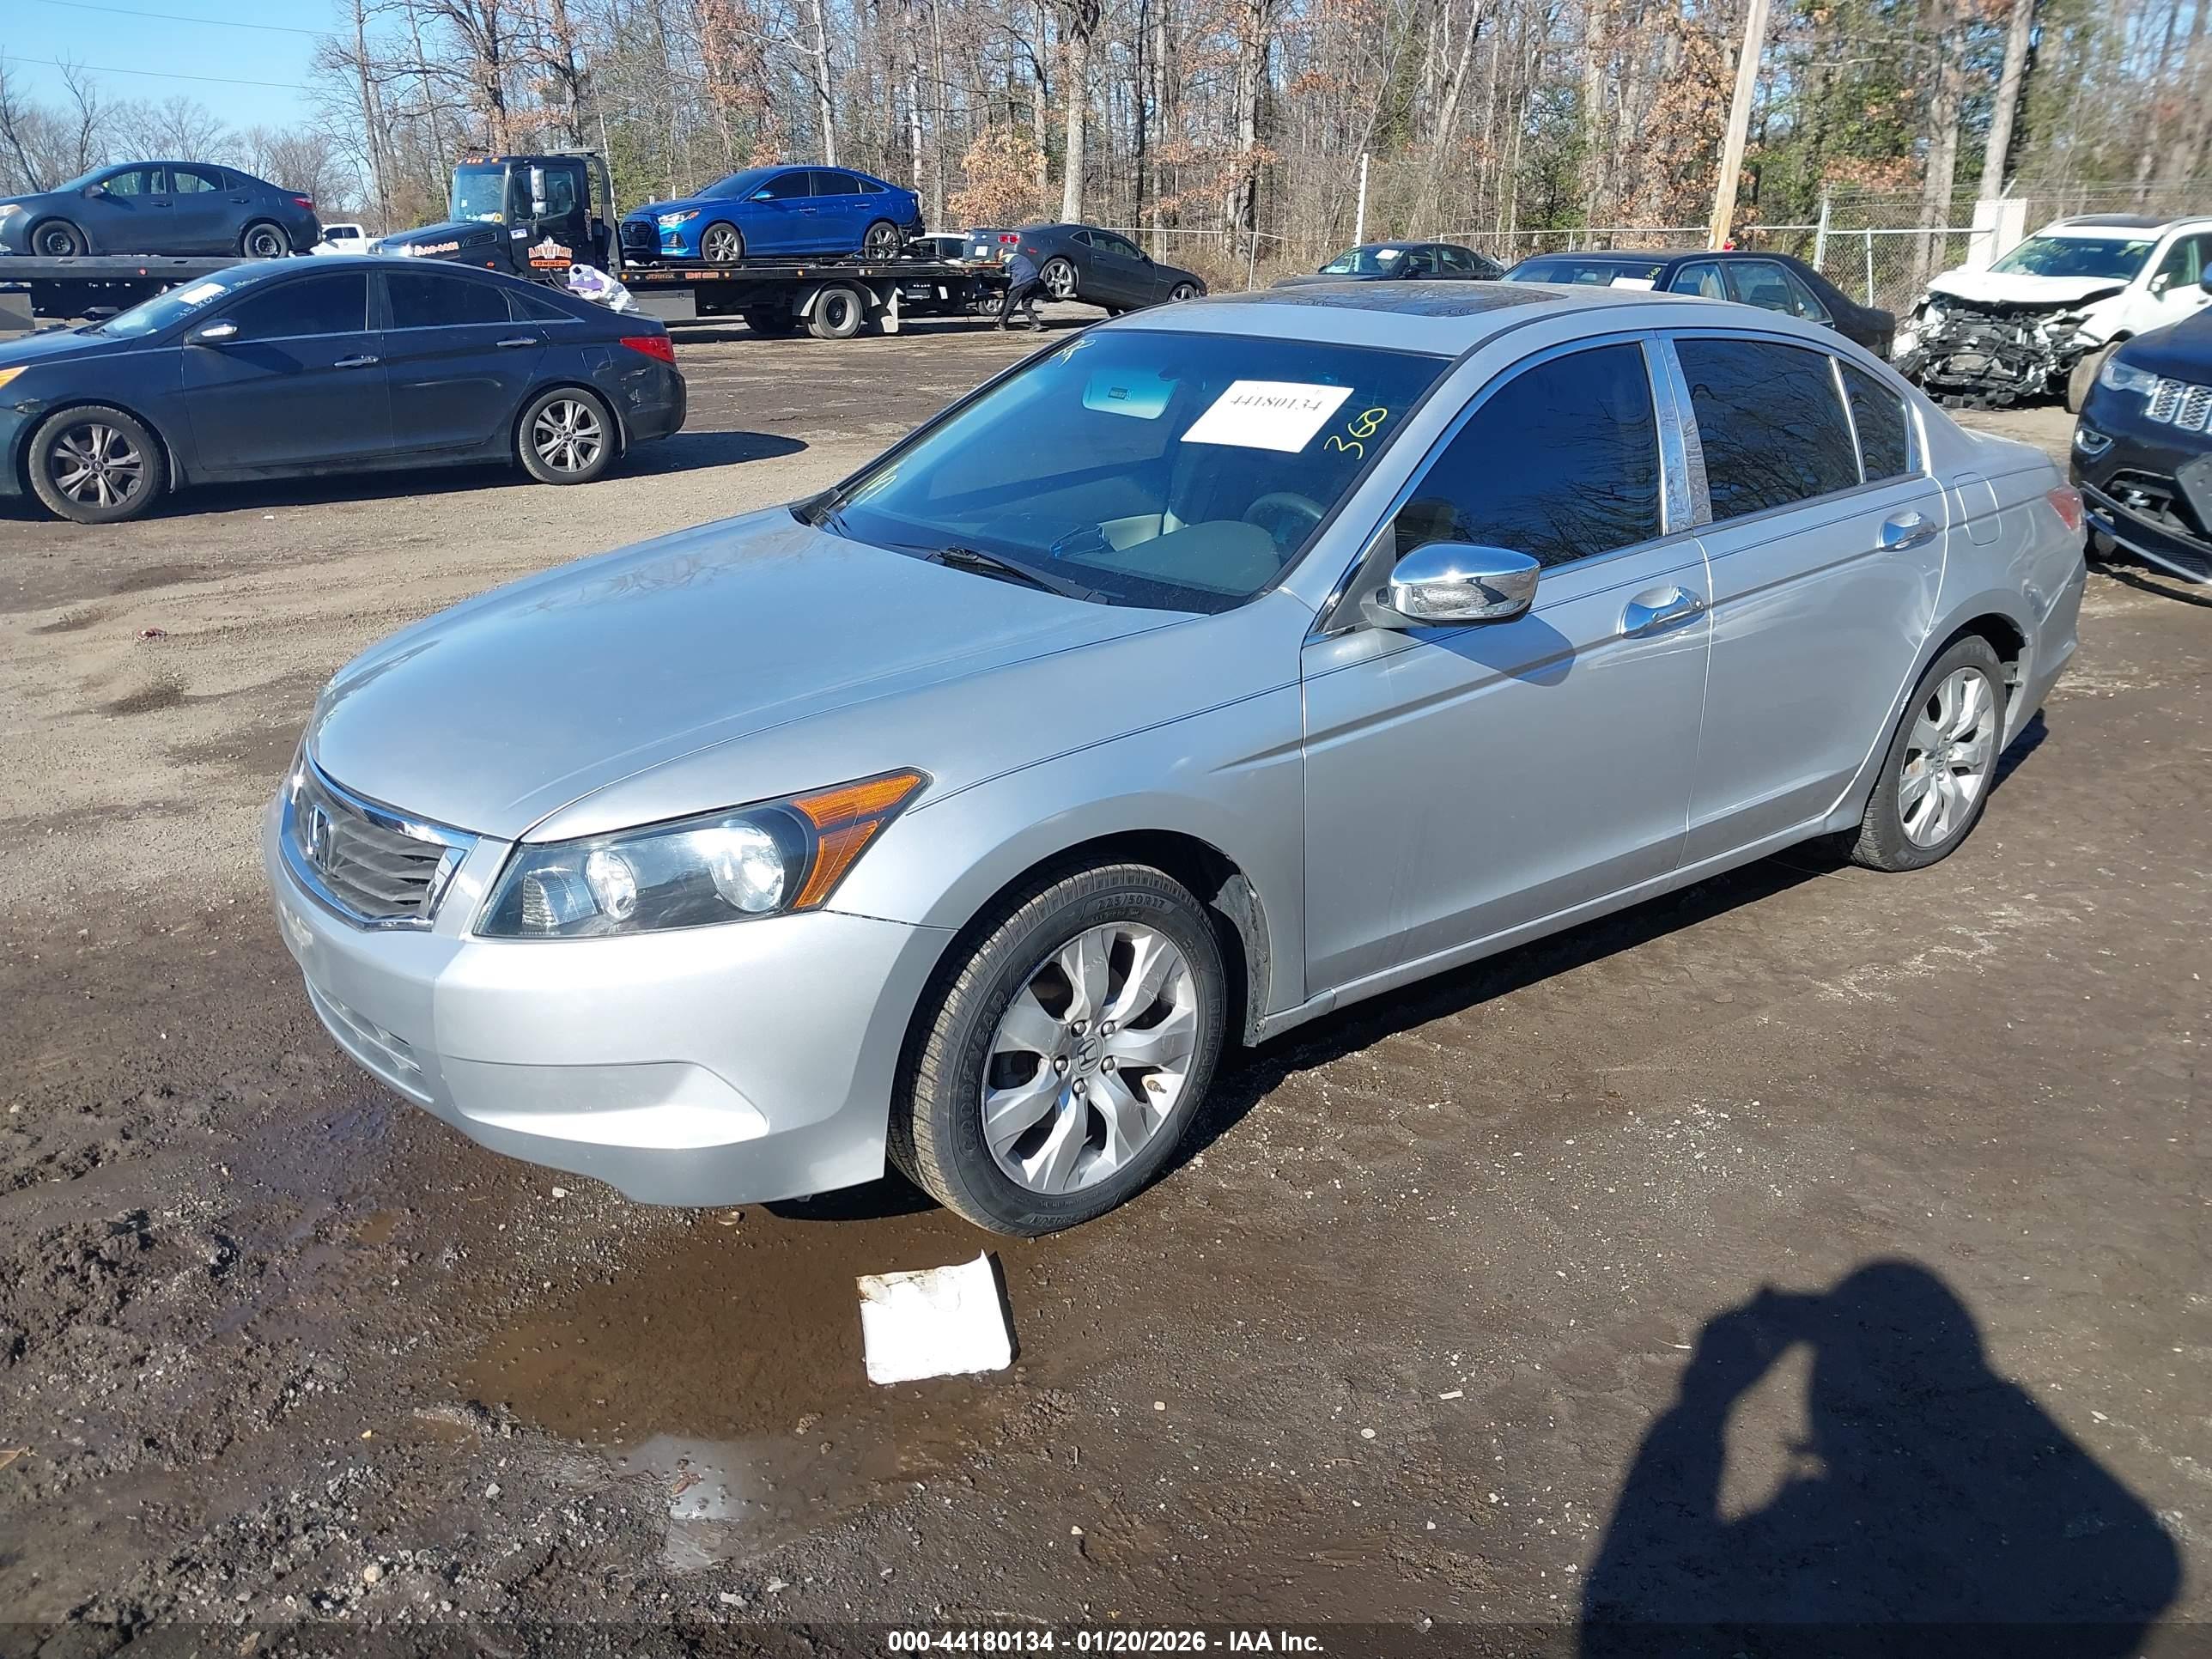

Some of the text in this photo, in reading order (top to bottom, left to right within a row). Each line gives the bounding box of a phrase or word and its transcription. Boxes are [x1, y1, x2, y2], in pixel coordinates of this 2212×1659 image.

[529, 246, 572, 258] ANYTIME
[1645, 267, 1662, 280] 360
[1230, 395, 1323, 411] 44180134
[1323, 407, 1388, 460] 360
[1098, 895, 1165, 909] 225/50R17
[961, 989, 1007, 1151] GOODYEAR
